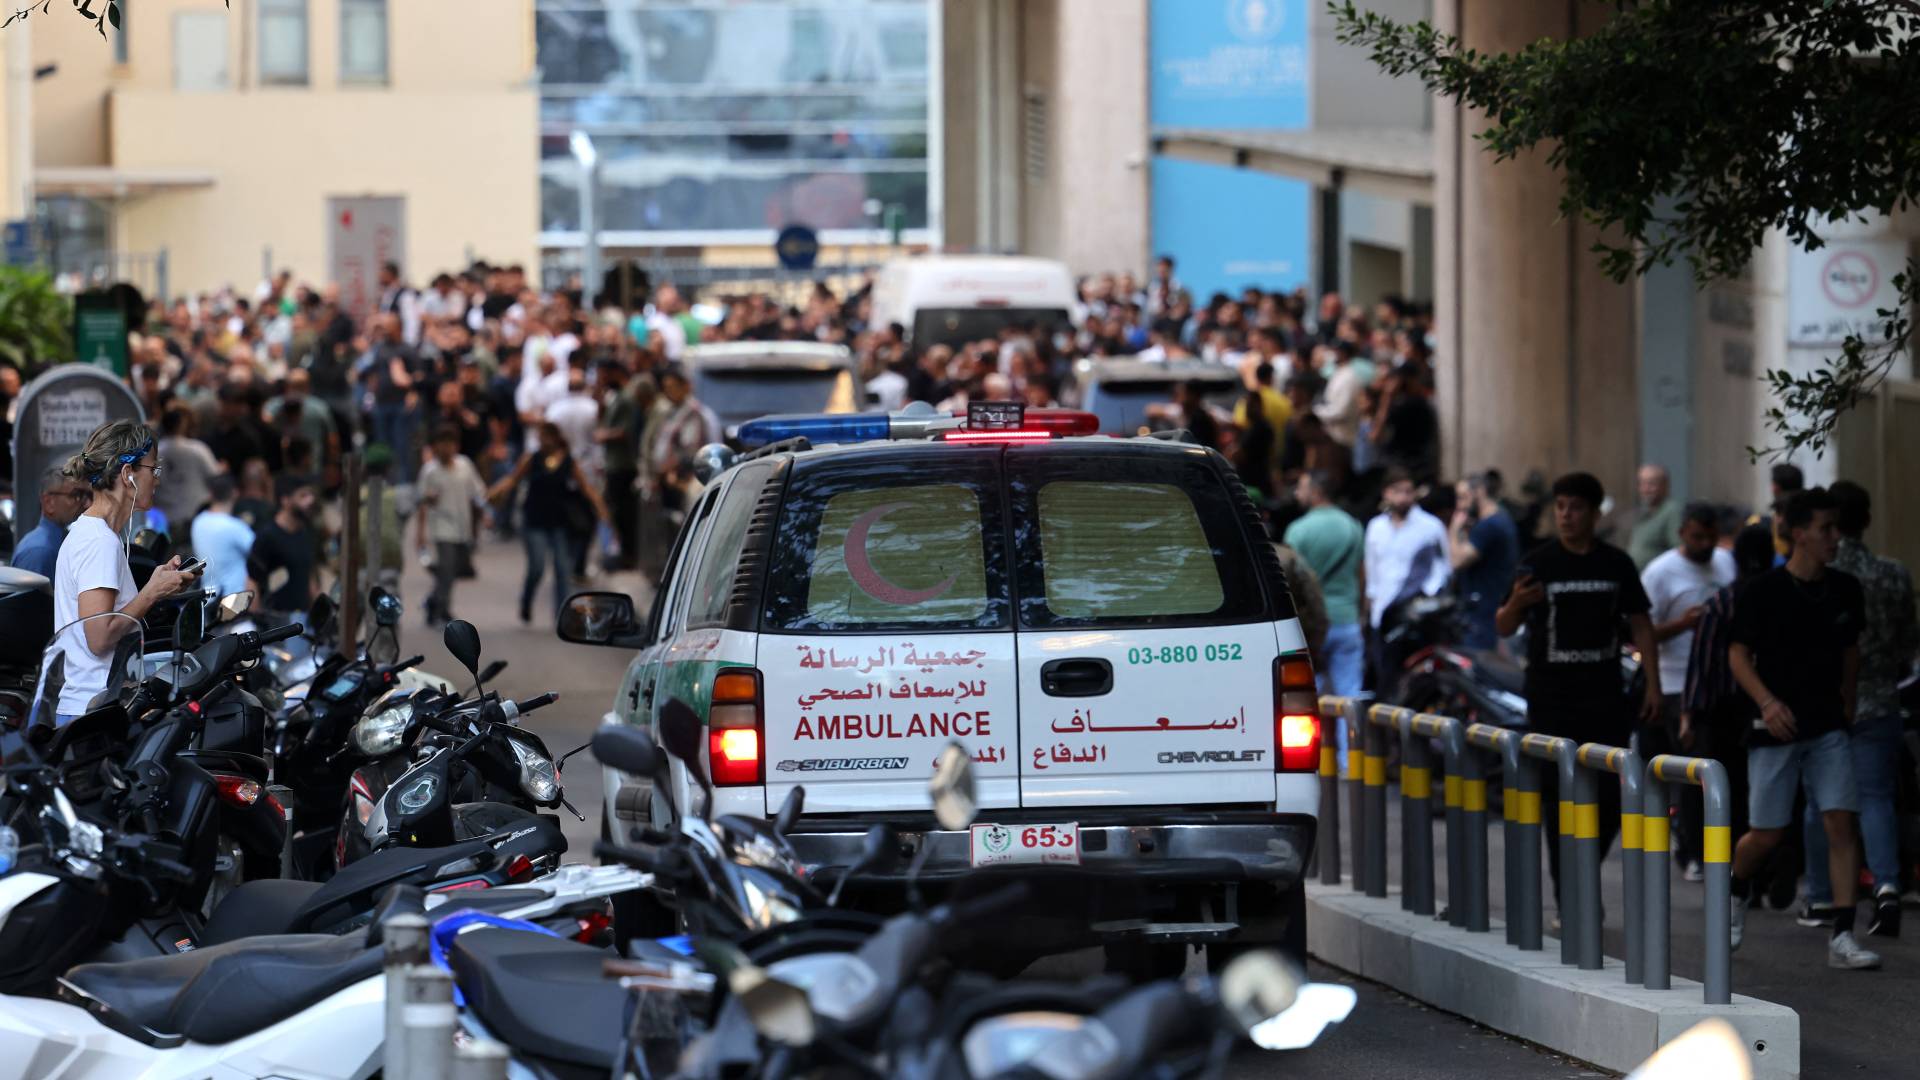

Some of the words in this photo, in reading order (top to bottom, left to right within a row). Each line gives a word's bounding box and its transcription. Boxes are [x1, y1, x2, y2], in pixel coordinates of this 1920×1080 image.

[797, 645, 895, 674] الرسالة
[902, 642, 987, 674] جمعية
[1128, 644, 1198, 665] 03-880
[1205, 643, 1243, 662] 052
[797, 682, 882, 711] الصحي
[889, 676, 987, 705] للإسعاف
[793, 711, 991, 741] AMBULANCE
[799, 757, 909, 771] SUBURBAN
[1032, 743, 1106, 770] الدفاع
[1157, 749, 1266, 764] CHEVROLET
